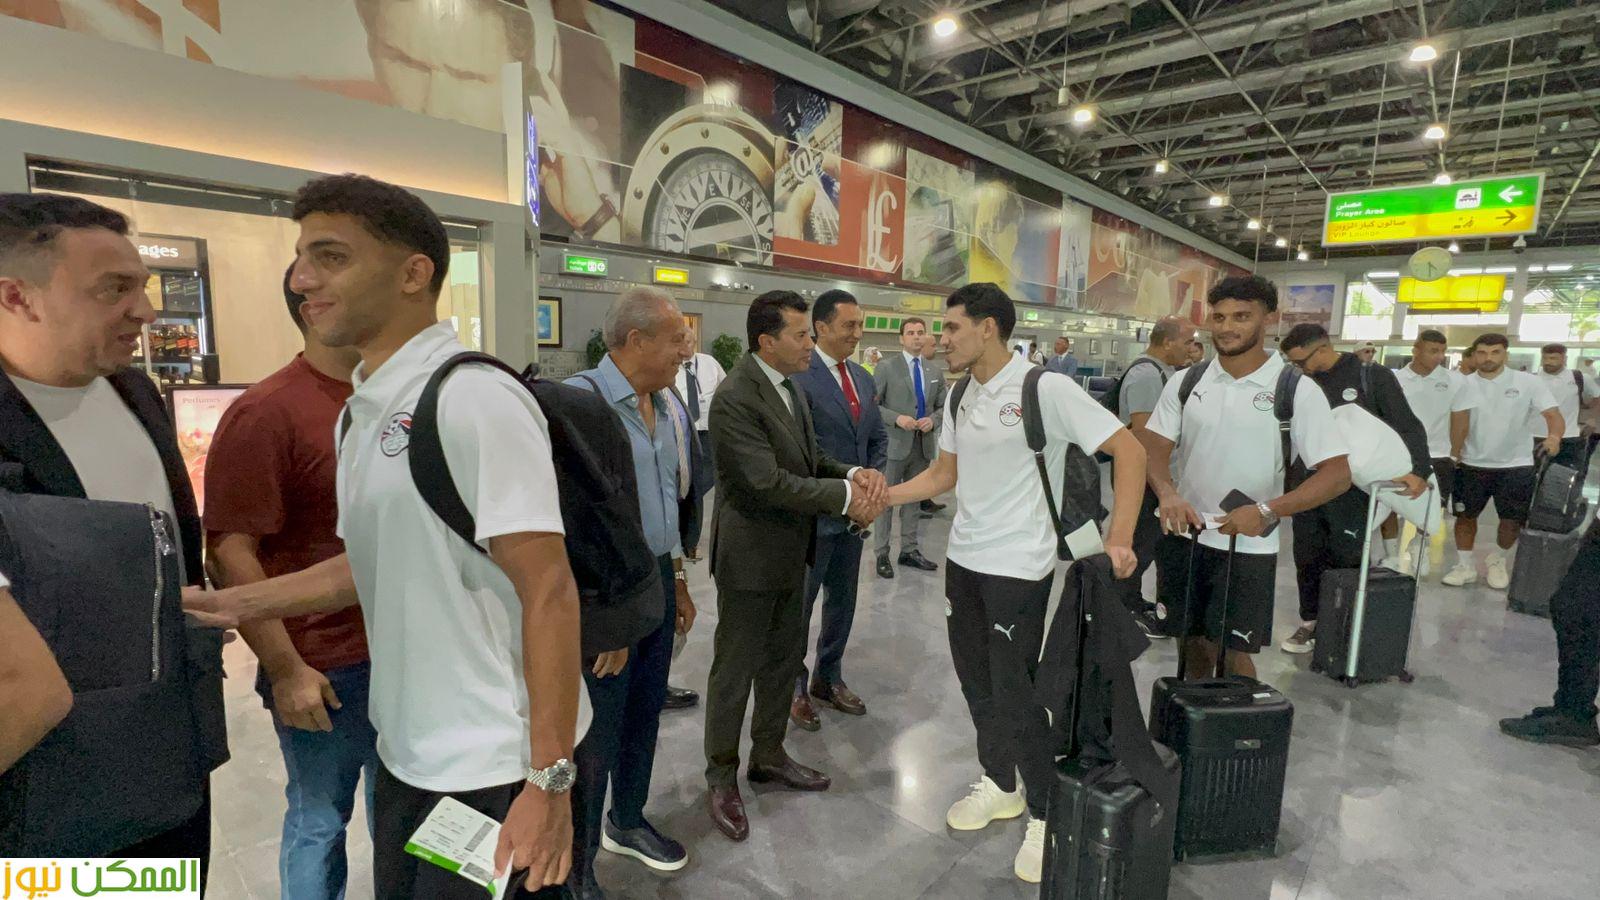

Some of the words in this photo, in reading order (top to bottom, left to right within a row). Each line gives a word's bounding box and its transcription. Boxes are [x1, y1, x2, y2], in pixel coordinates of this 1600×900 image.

[709, 184, 716, 197] E
[740, 196, 751, 212] SE
[138, 244, 179, 259] ages
